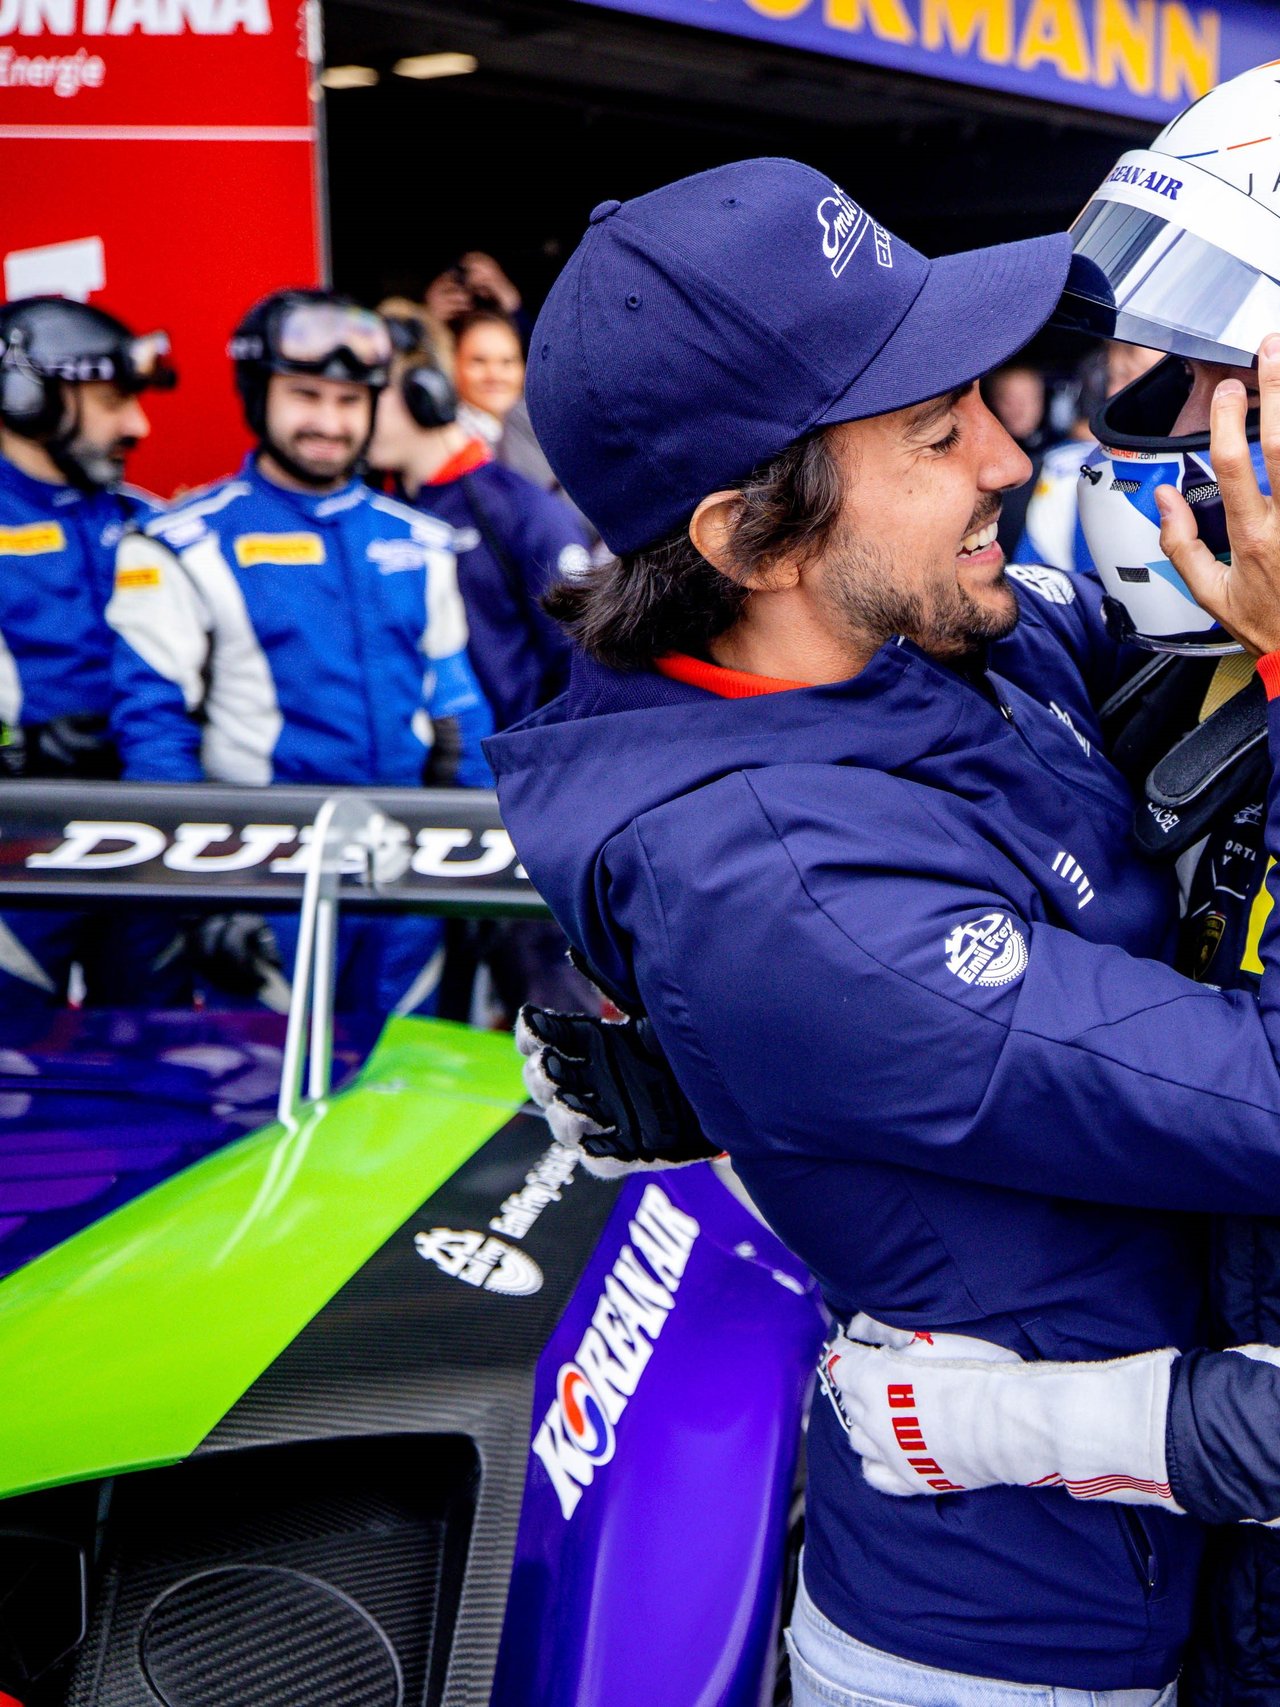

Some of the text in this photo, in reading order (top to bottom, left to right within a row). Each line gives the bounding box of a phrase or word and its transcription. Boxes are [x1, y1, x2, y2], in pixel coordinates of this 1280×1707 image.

[1139, 170, 1184, 201] AIR
[957, 917, 1014, 985] Emil Frey
[531, 1243, 676, 1521] KOREAN
[628, 1182, 701, 1293] AIR
